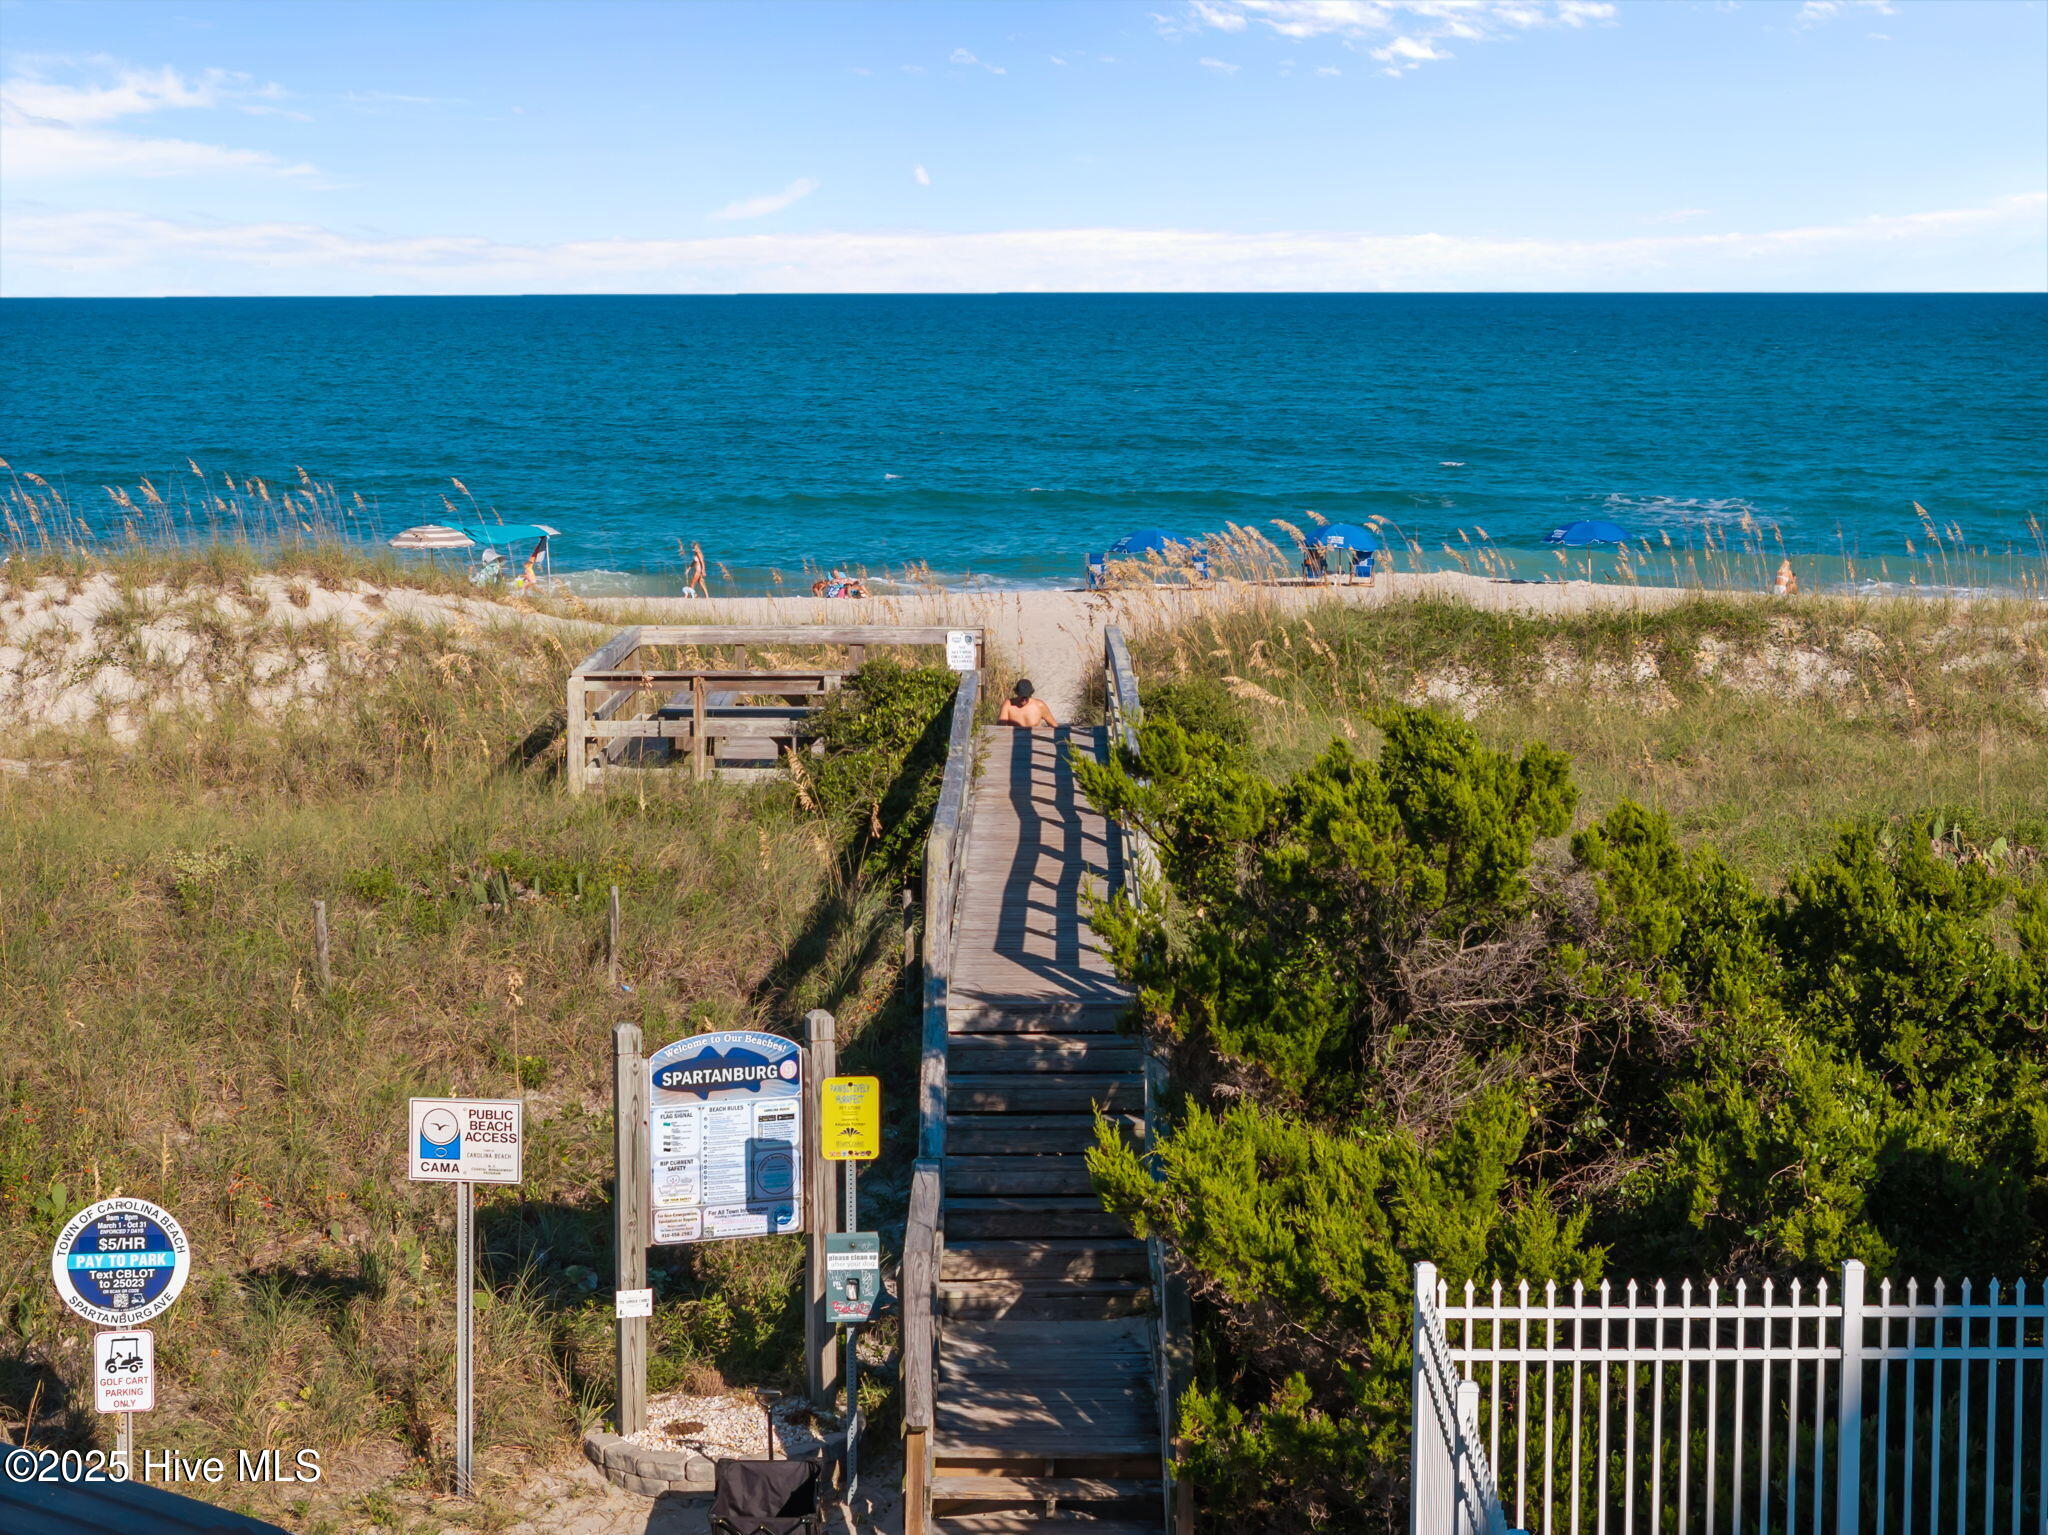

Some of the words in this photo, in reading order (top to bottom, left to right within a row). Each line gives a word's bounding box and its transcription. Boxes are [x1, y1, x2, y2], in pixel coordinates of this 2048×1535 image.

[664, 1038, 708, 1058] Welcome
[710, 1036, 721, 1044] to
[723, 1034, 743, 1043] Our
[745, 1034, 787, 1053] Beaches!
[662, 1064, 778, 1087] SPARTANBURG
[468, 1109, 514, 1120] PUBLIC
[469, 1121, 513, 1132] BEACH
[464, 1132, 517, 1144] ACCESS
[420, 1161, 460, 1173] CAMA
[56, 1223, 80, 1257] TOWN
[79, 1210, 95, 1224] OF
[97, 1200, 159, 1220] CAROLINA
[160, 1215, 186, 1254] BEACH
[98, 1237, 146, 1251] $5/HR
[76, 1255, 105, 1268] PAY
[108, 1254, 125, 1267] TO
[130, 1253, 167, 1266] PARK
[828, 1254, 850, 1262] please
[89, 1270, 113, 1279] Text
[116, 1269, 155, 1278] CBLOT
[99, 1280, 111, 1288] to
[113, 1279, 145, 1288] 25023
[69, 1295, 153, 1324] SPARTANBURG
[153, 1292, 173, 1313] AVE
[100, 1377, 123, 1386] GOLF
[126, 1376, 148, 1384] CART
[105, 1387, 143, 1397] PARKING
[113, 1400, 136, 1408] ONLY
